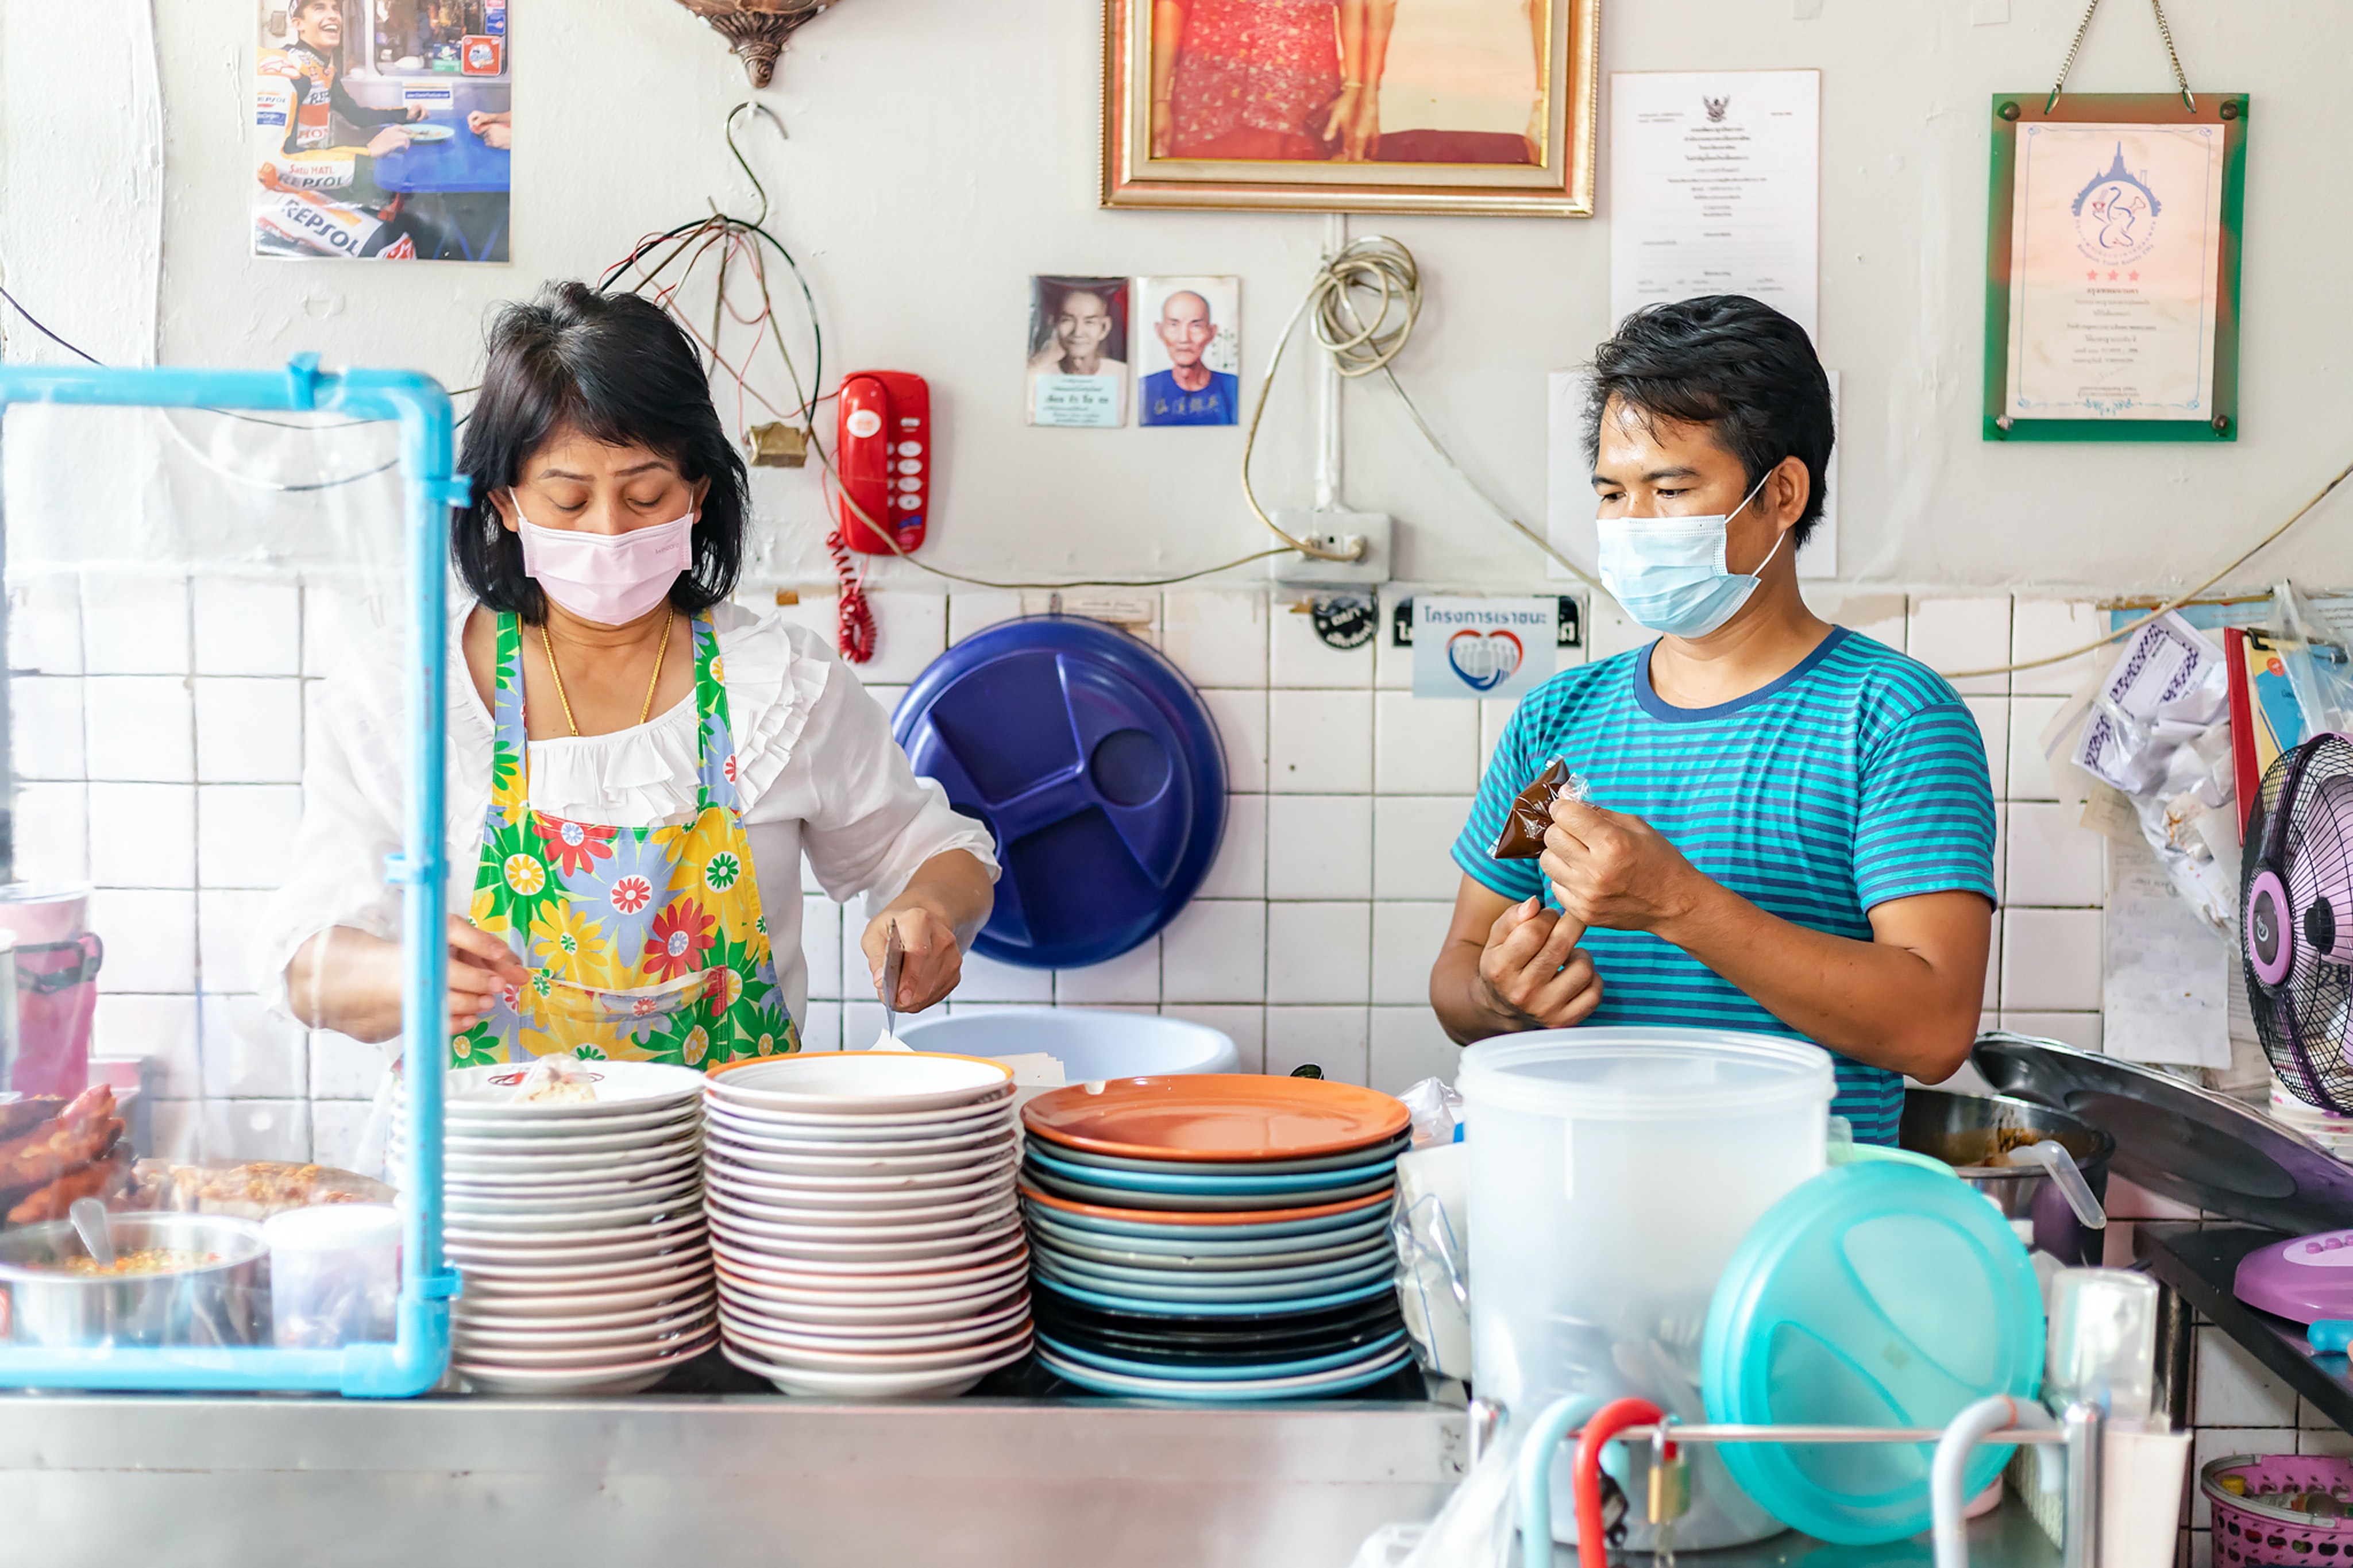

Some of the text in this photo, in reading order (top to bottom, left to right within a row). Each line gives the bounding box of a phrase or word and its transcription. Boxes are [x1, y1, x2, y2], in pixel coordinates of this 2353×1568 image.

[281, 199, 359, 256] REPSOL
[1424, 605, 1547, 624] โครงการเราชนะ
